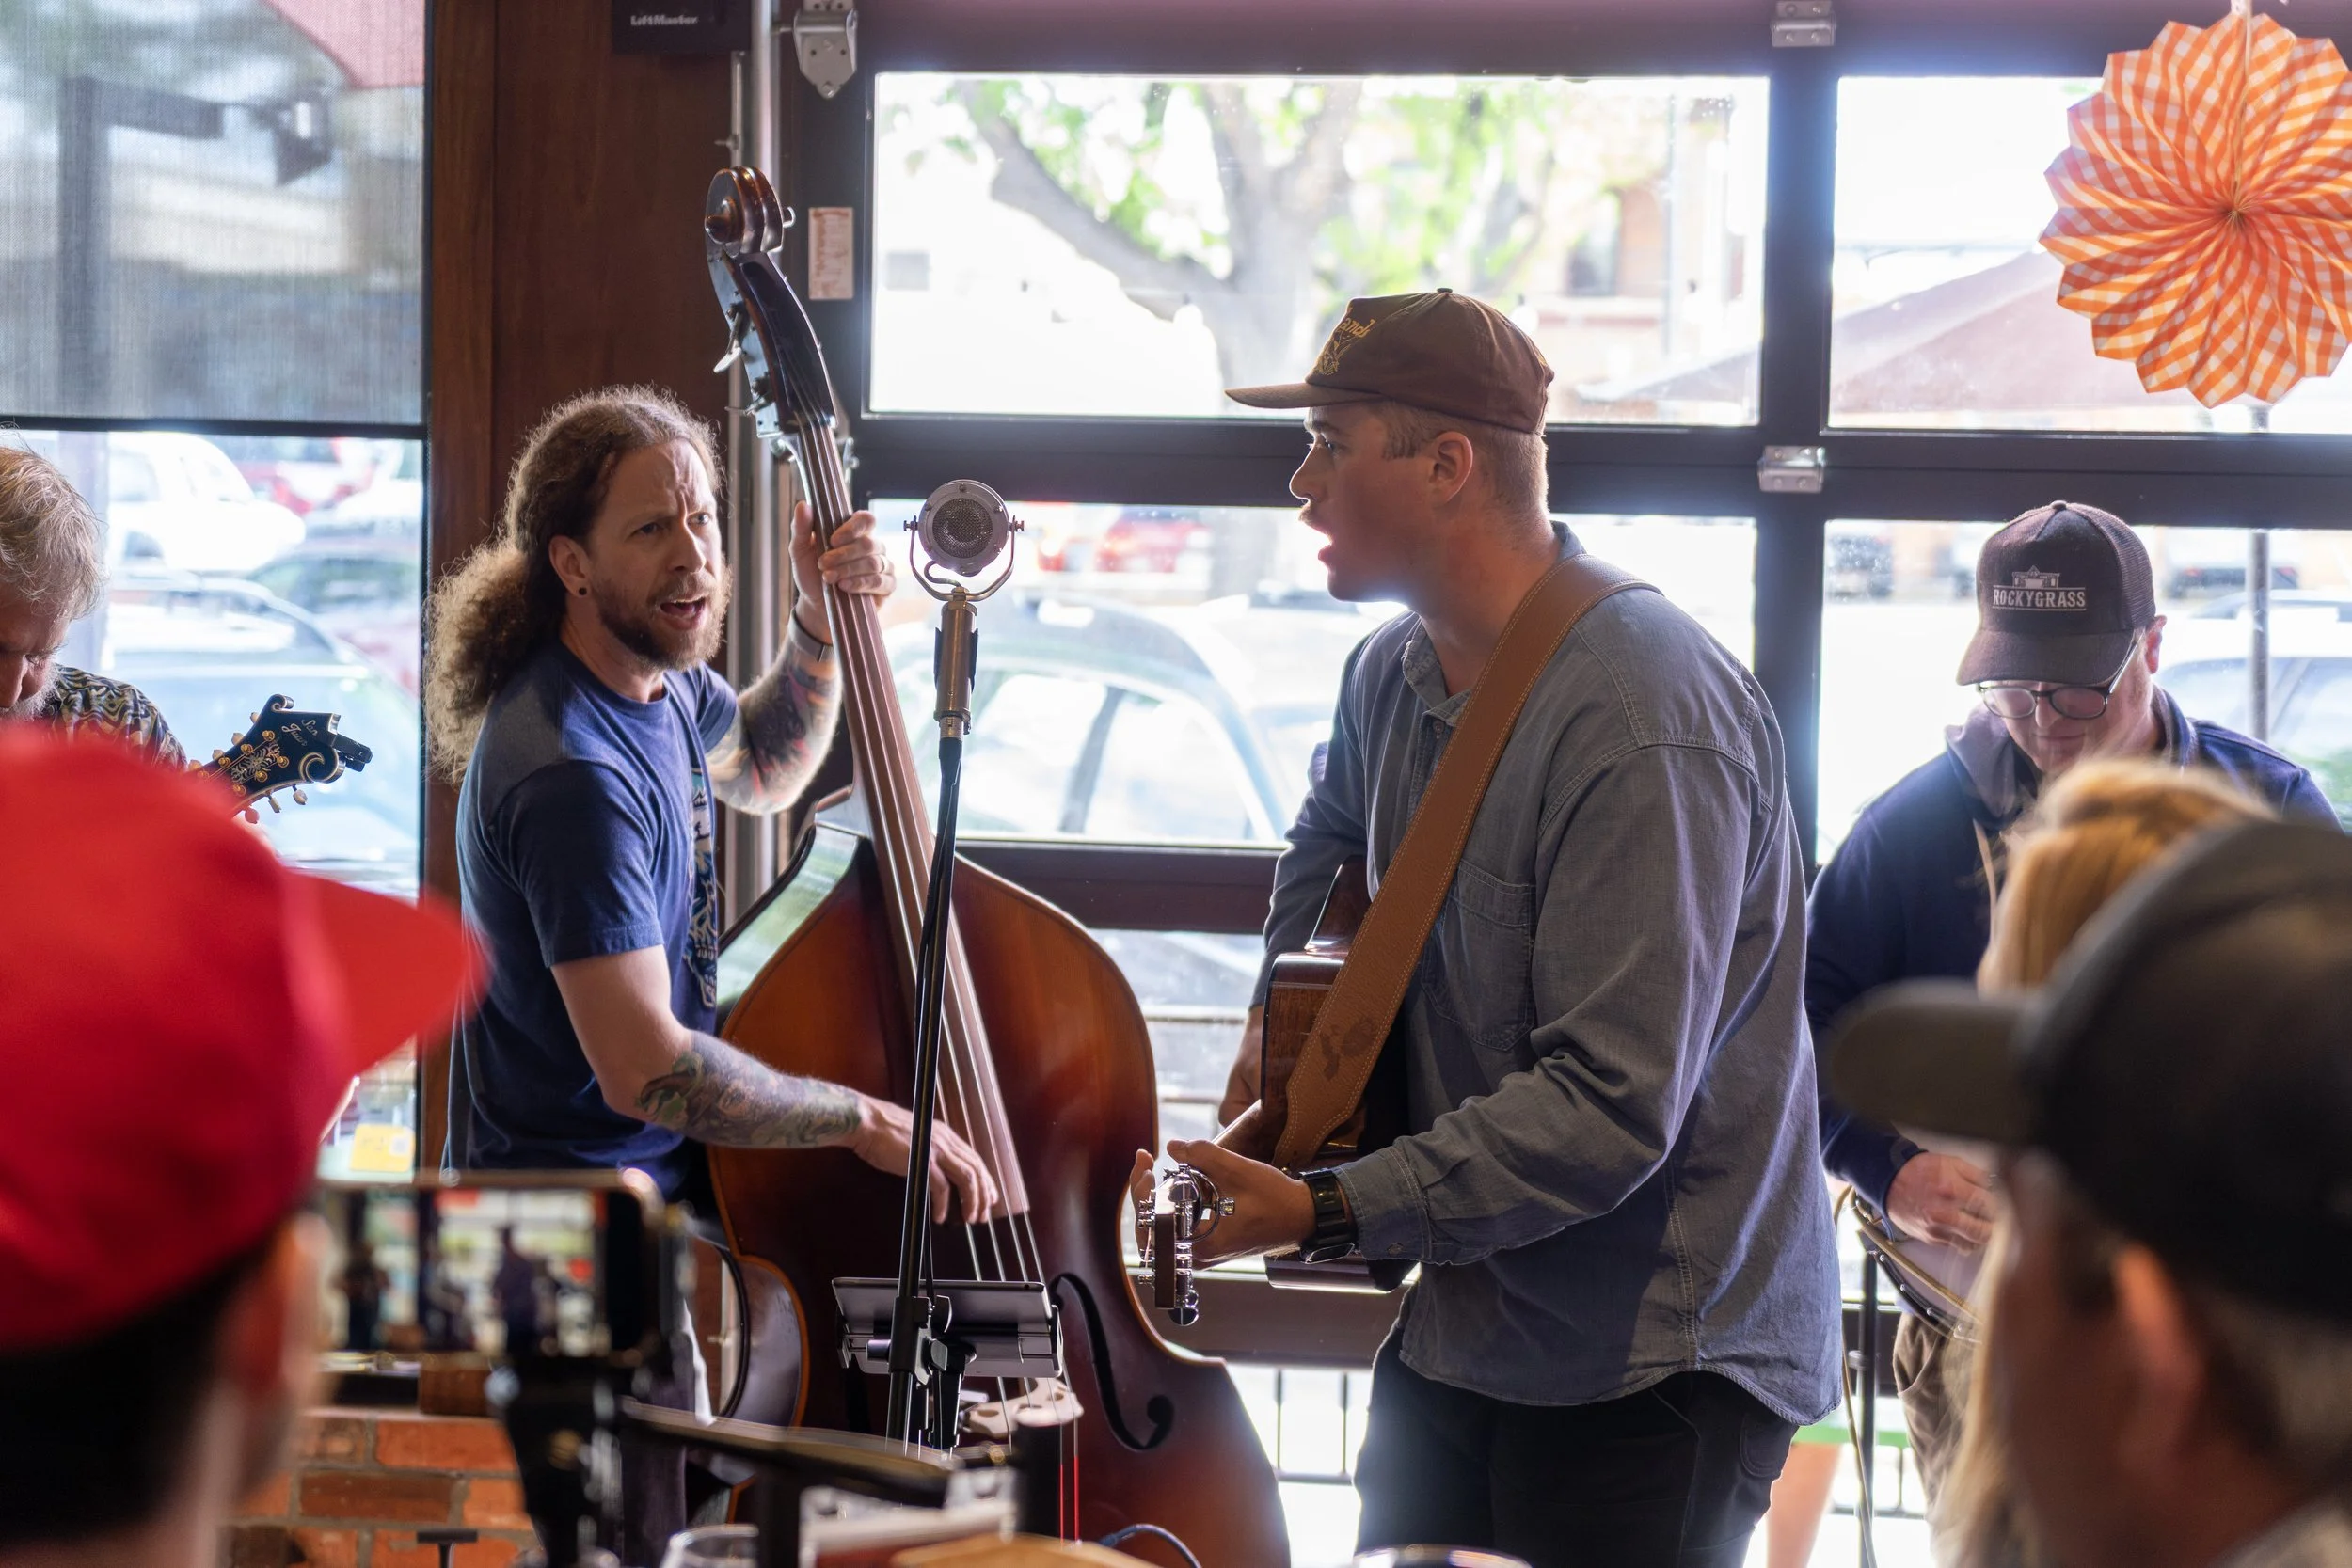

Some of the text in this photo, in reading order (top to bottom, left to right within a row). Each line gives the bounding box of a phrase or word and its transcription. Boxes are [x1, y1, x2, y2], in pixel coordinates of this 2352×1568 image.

[1994, 589, 2086, 608] ROCKYGRASS
[281, 723, 308, 746] Juan
[301, 720, 318, 736] San
